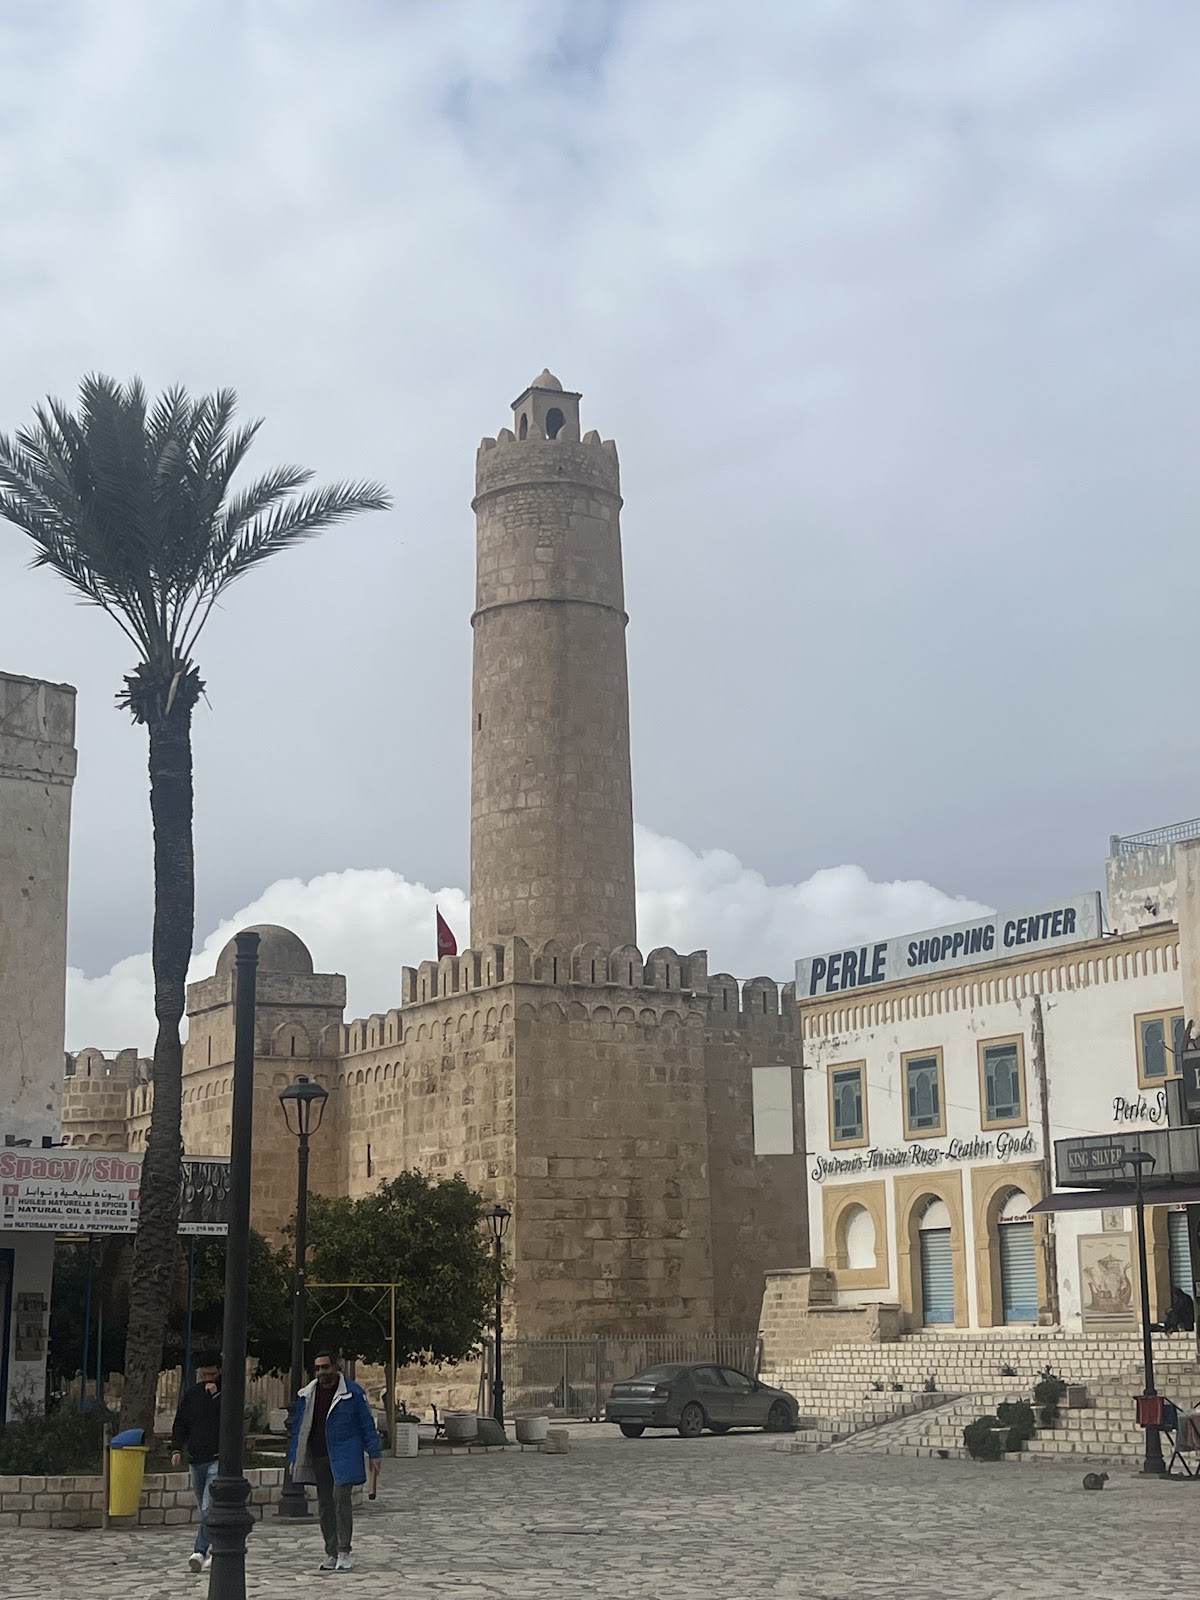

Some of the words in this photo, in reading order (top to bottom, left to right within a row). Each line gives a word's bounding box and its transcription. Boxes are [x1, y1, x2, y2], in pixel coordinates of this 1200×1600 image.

[809, 942, 888, 996] PERLE
[907, 924, 995, 968] SHOPPING
[1003, 907, 1077, 948] CENTER
[1112, 1094, 1147, 1122] Perle
[996, 1130, 1033, 1160] Goods
[1068, 1151, 1089, 1168] KING
[0, 1152, 78, 1183] Spacy
[93, 1157, 142, 1184] Sho
[18, 1206, 63, 1214] NATURAL
[66, 1207, 81, 1215] OIL
[94, 1208, 128, 1216] SPICES
